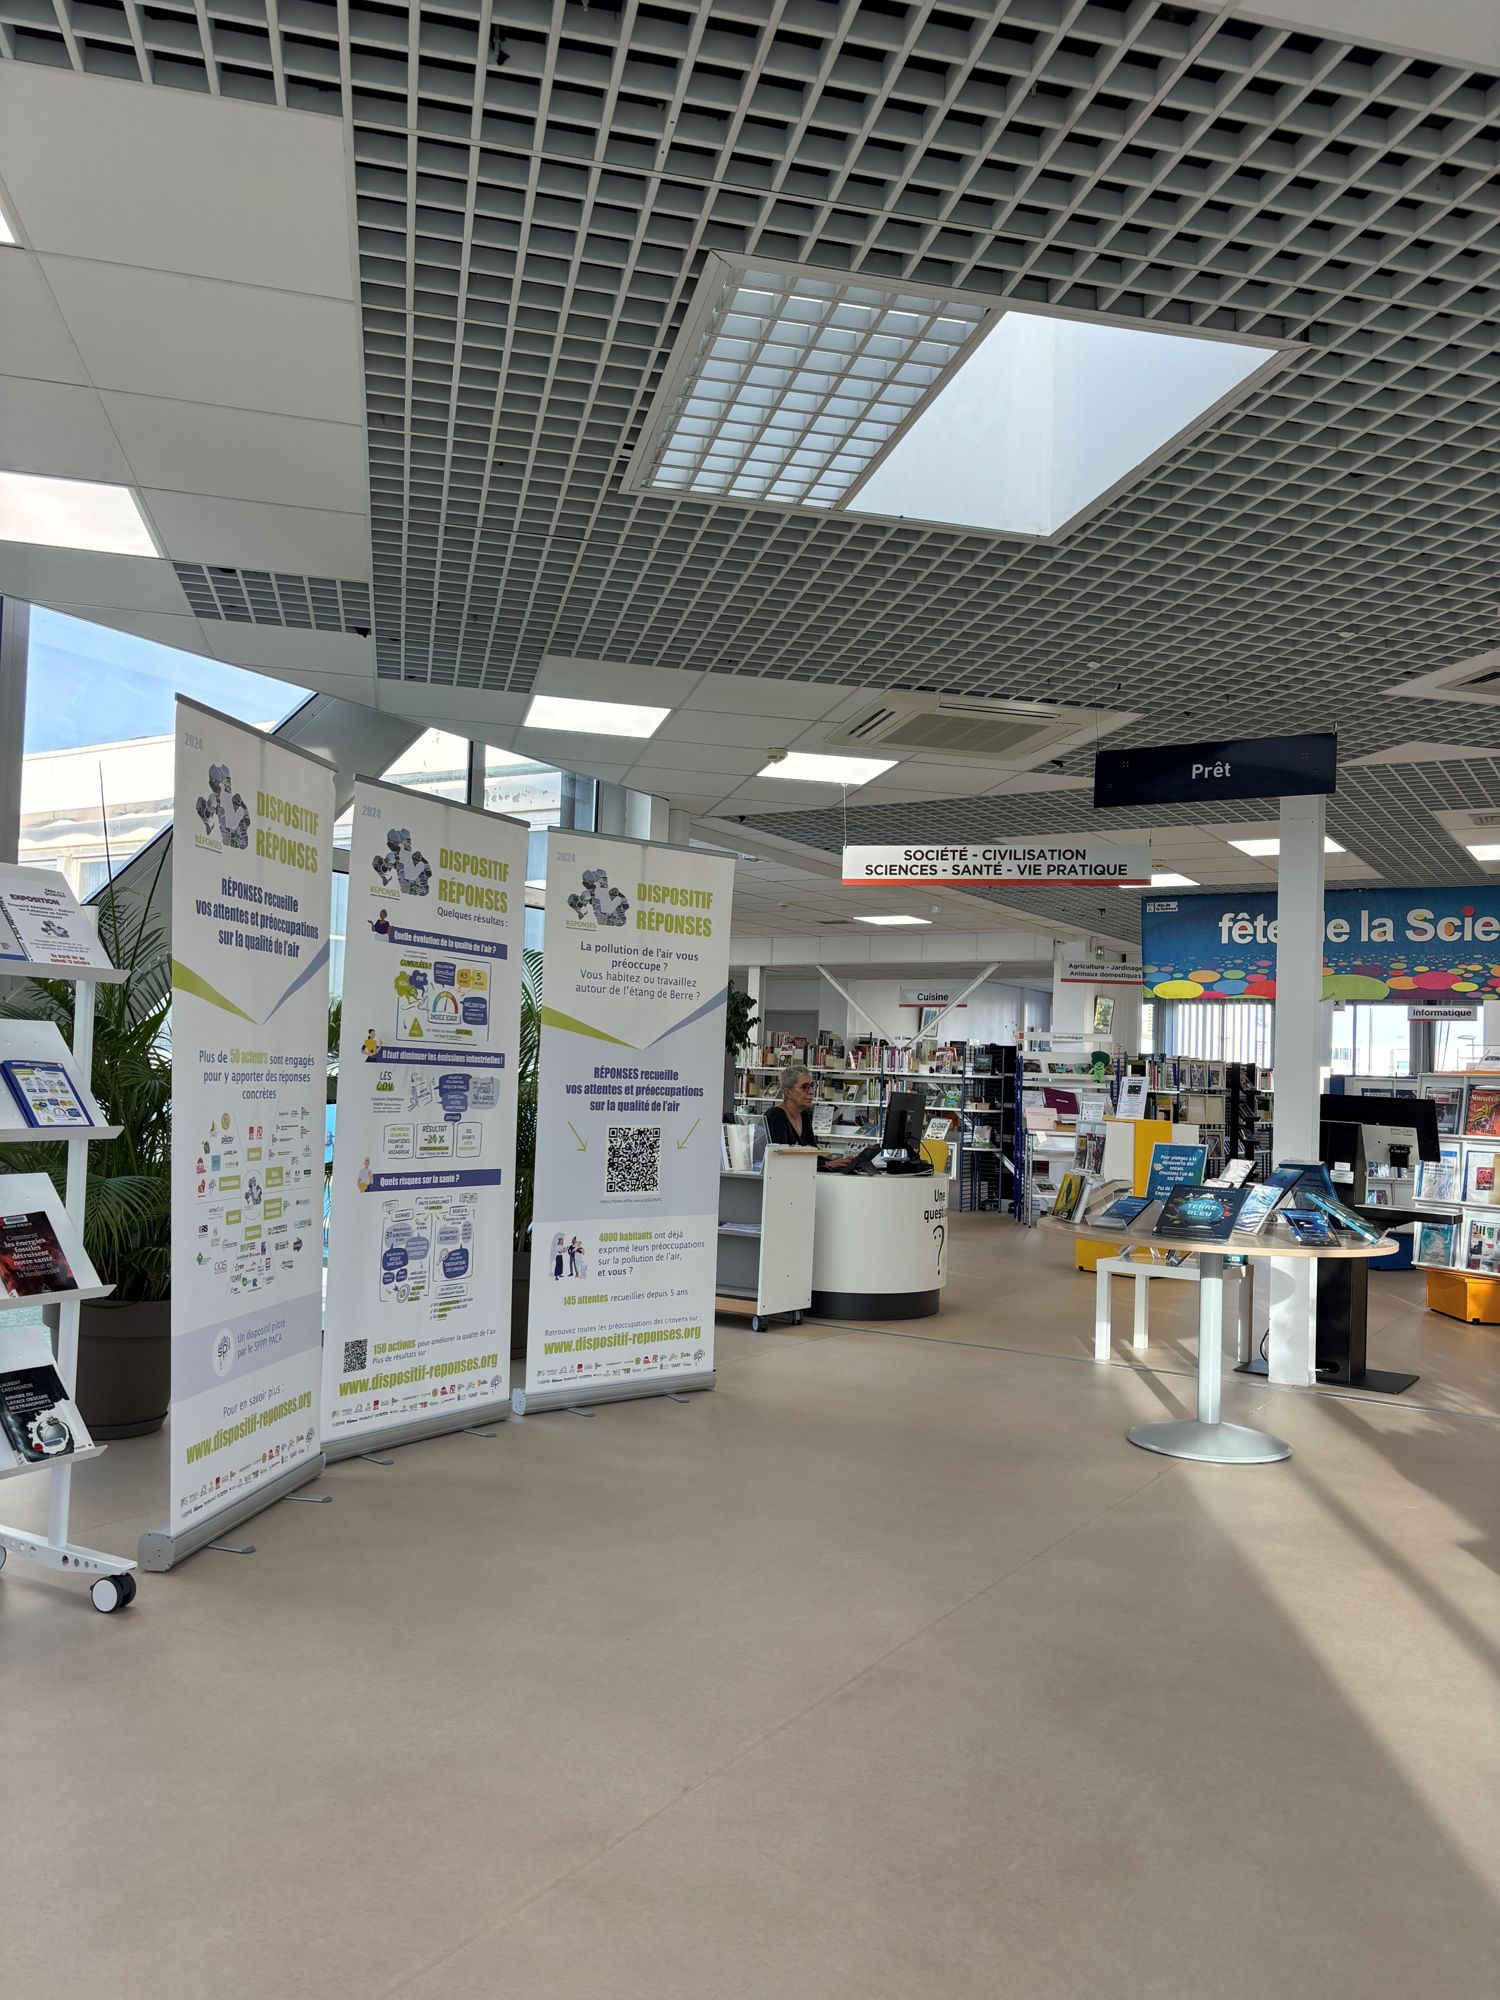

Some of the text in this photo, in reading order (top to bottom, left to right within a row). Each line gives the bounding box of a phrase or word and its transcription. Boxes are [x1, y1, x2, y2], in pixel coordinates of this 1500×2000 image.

[184, 733, 203, 751] 2024
[1191, 761, 1231, 779] Prêt
[256, 791, 318, 836] DISPOSITIF
[362, 805, 381, 819] 2024
[256, 828, 318, 874] RÉPONSES
[556, 851, 576, 862] 2024
[903, 847, 1086, 861] SOCIÉTÉ CIVILISATION
[440, 848, 509, 882] DISPOSITIF
[865, 861, 1128, 876] SCIENCES SANTÉ VIE PRATIQUE
[10, 894, 60, 905] EXPOSITION
[222, 877, 298, 913] RÉPONSES recueille
[438, 878, 508, 914] RÉPONSES
[637, 883, 713, 909] DISPOSITIF
[196, 899, 318, 939] vos attentes et préoccupations
[437, 907, 505, 927] Quelques résultats
[636, 909, 712, 937] RÉPONSES
[1361, 910, 1395, 942] la
[219, 929, 299, 957] sur la qualité de l'air
[394, 930, 492, 953] Quelle évolution de la qualité de l'air
[581, 942, 698, 961] La pollution de l'air vous
[611, 959, 661, 972] préoccupe
[580, 970, 696, 987] Vous habitez ou travaillez
[576, 984, 693, 1000] autour de l'étang de Berre
[1413, 1009, 1471, 1017] Informatique
[199, 1049, 314, 1066] Plus de 50 acteurs sont engagés
[382, 1048, 500, 1064] Il faut diminuer les émissions industrielles
[203, 1070, 310, 1084] pour y apporter des réponses
[380, 1072, 392, 1080] LES
[594, 1065, 678, 1080] RÉPONSES recueille
[242, 1088, 276, 1100] concrètes
[566, 1084, 703, 1097] vos attentes et préoccupations
[590, 1100, 680, 1112] sur la qualité de l'air
[422, 1125, 447, 1133] RÉSULTAT
[380, 1173, 454, 1187] Quels risques sur la santé
[935, 1189, 945, 1202] Une
[16, 1238, 46, 1247] énergies
[599, 1233, 618, 1242] 4000
[619, 1231, 652, 1241] habitants
[668, 1230, 683, 1240] déjà
[12, 1250, 49, 1259] détruisent
[598, 1241, 705, 1254] exprimé leurs préoccupations
[613, 1256, 620, 1264] la
[621, 1254, 653, 1265] pollution
[655, 1253, 664, 1261] de
[666, 1252, 682, 1261] l'air,
[608, 1268, 626, 1276] vous
[577, 1294, 608, 1305] attentes
[611, 1292, 645, 1302] recueillies
[647, 1289, 668, 1299] depuis
[545, 1327, 575, 1336] Retrouvez
[577, 1324, 597, 1333] toutes
[598, 1322, 606, 1331] les
[608, 1319, 652, 1331] préoccupations
[653, 1317, 663, 1325] des
[664, 1316, 687, 1326] citoyens
[388, 1339, 416, 1352] actions
[417, 1340, 430, 1349] pour
[431, 1336, 455, 1346] améliorer
[462, 1330, 478, 1340] qualité
[479, 1328, 485, 1336] de
[486, 1328, 497, 1336] l'air
[544, 1325, 701, 1354] www.dispositif-reponses.org
[372, 1357, 384, 1365] Plus
[393, 1351, 416, 1361] résultats
[339, 1353, 498, 1397] www.dispositif-reponses.org
[223, 1384, 281, 1418] Pour en savoir plus
[186, 1391, 312, 1464] www.dispositif-reponses.org
